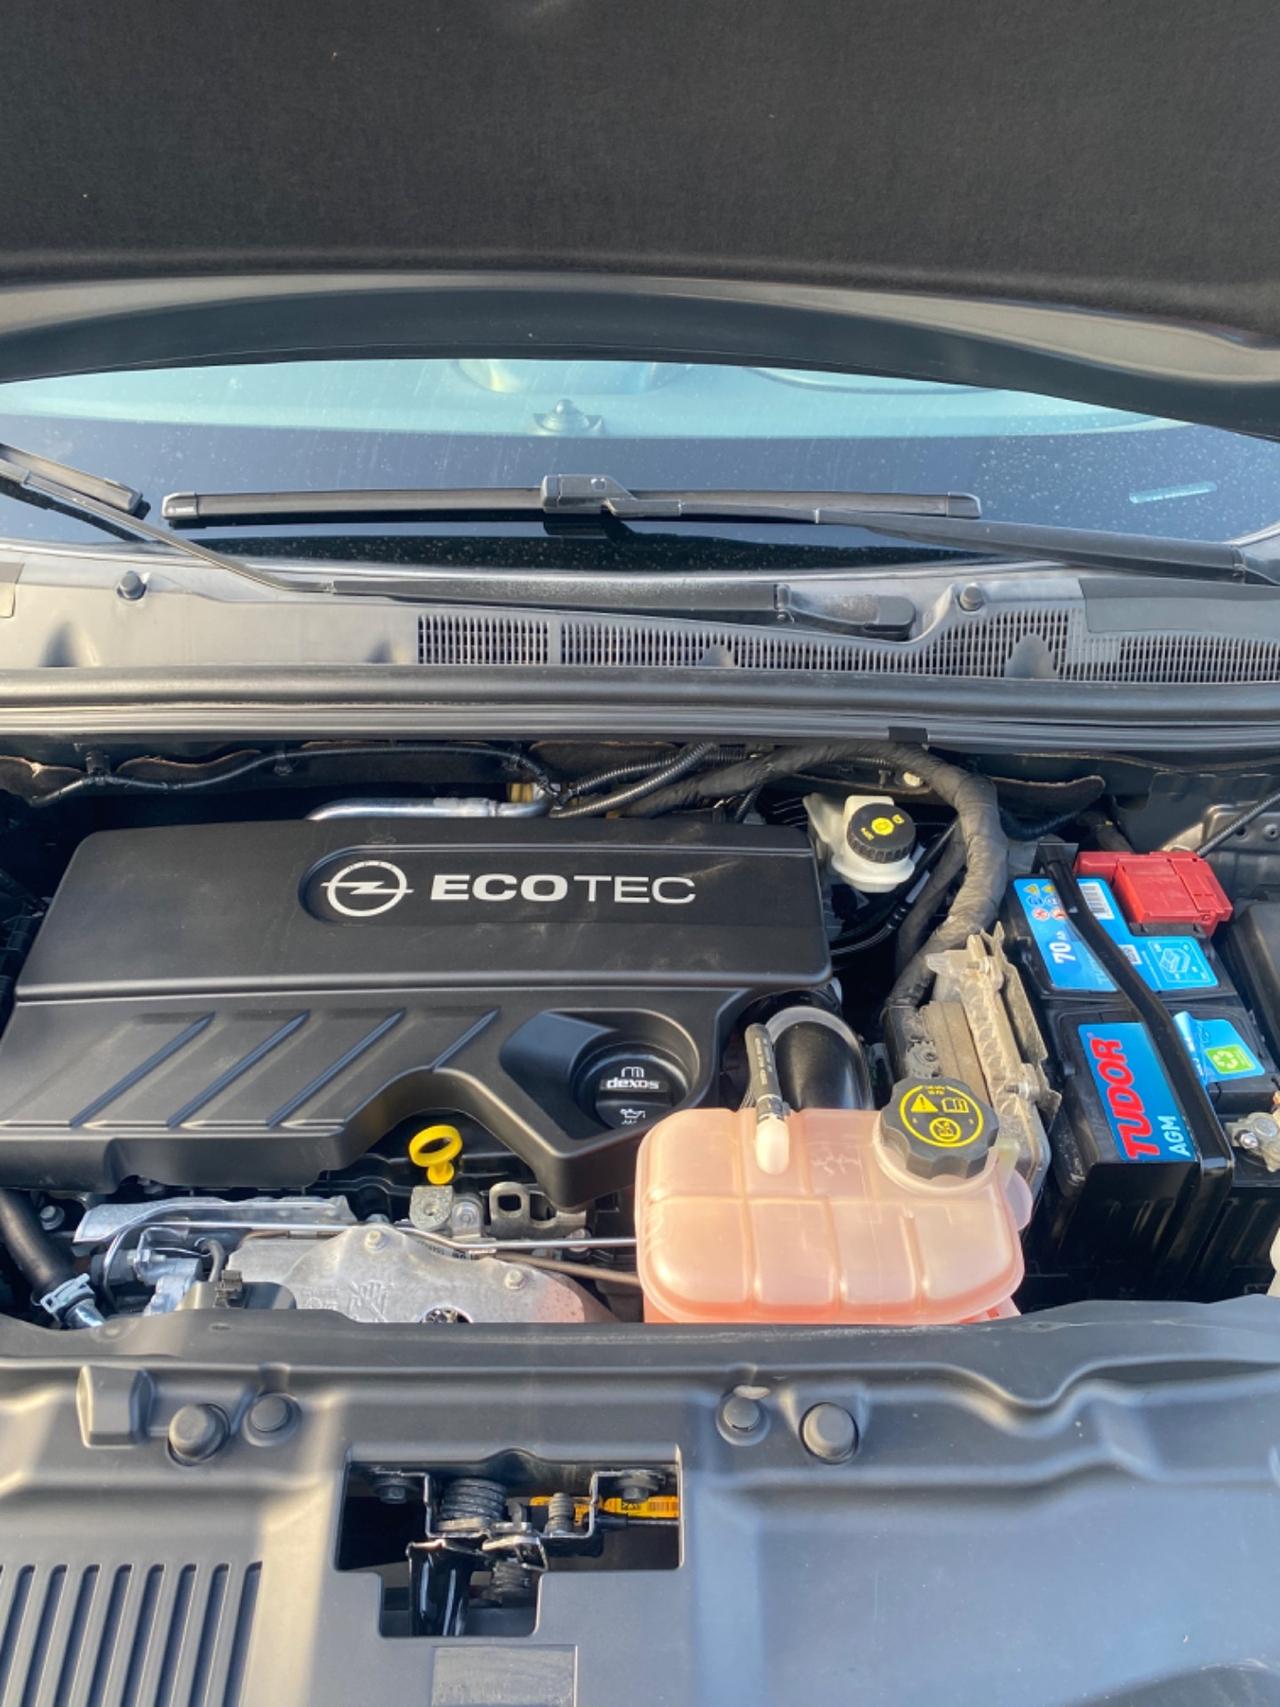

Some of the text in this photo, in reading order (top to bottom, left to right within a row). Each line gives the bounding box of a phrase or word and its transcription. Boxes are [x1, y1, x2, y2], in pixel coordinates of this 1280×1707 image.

[430, 873, 697, 904] ECOTEC
[1049, 942, 1076, 964] 70
[606, 1077, 660, 1090] dexos
[1090, 1037, 1160, 1160] TUDOR
[1157, 1115, 1191, 1157] AGM
